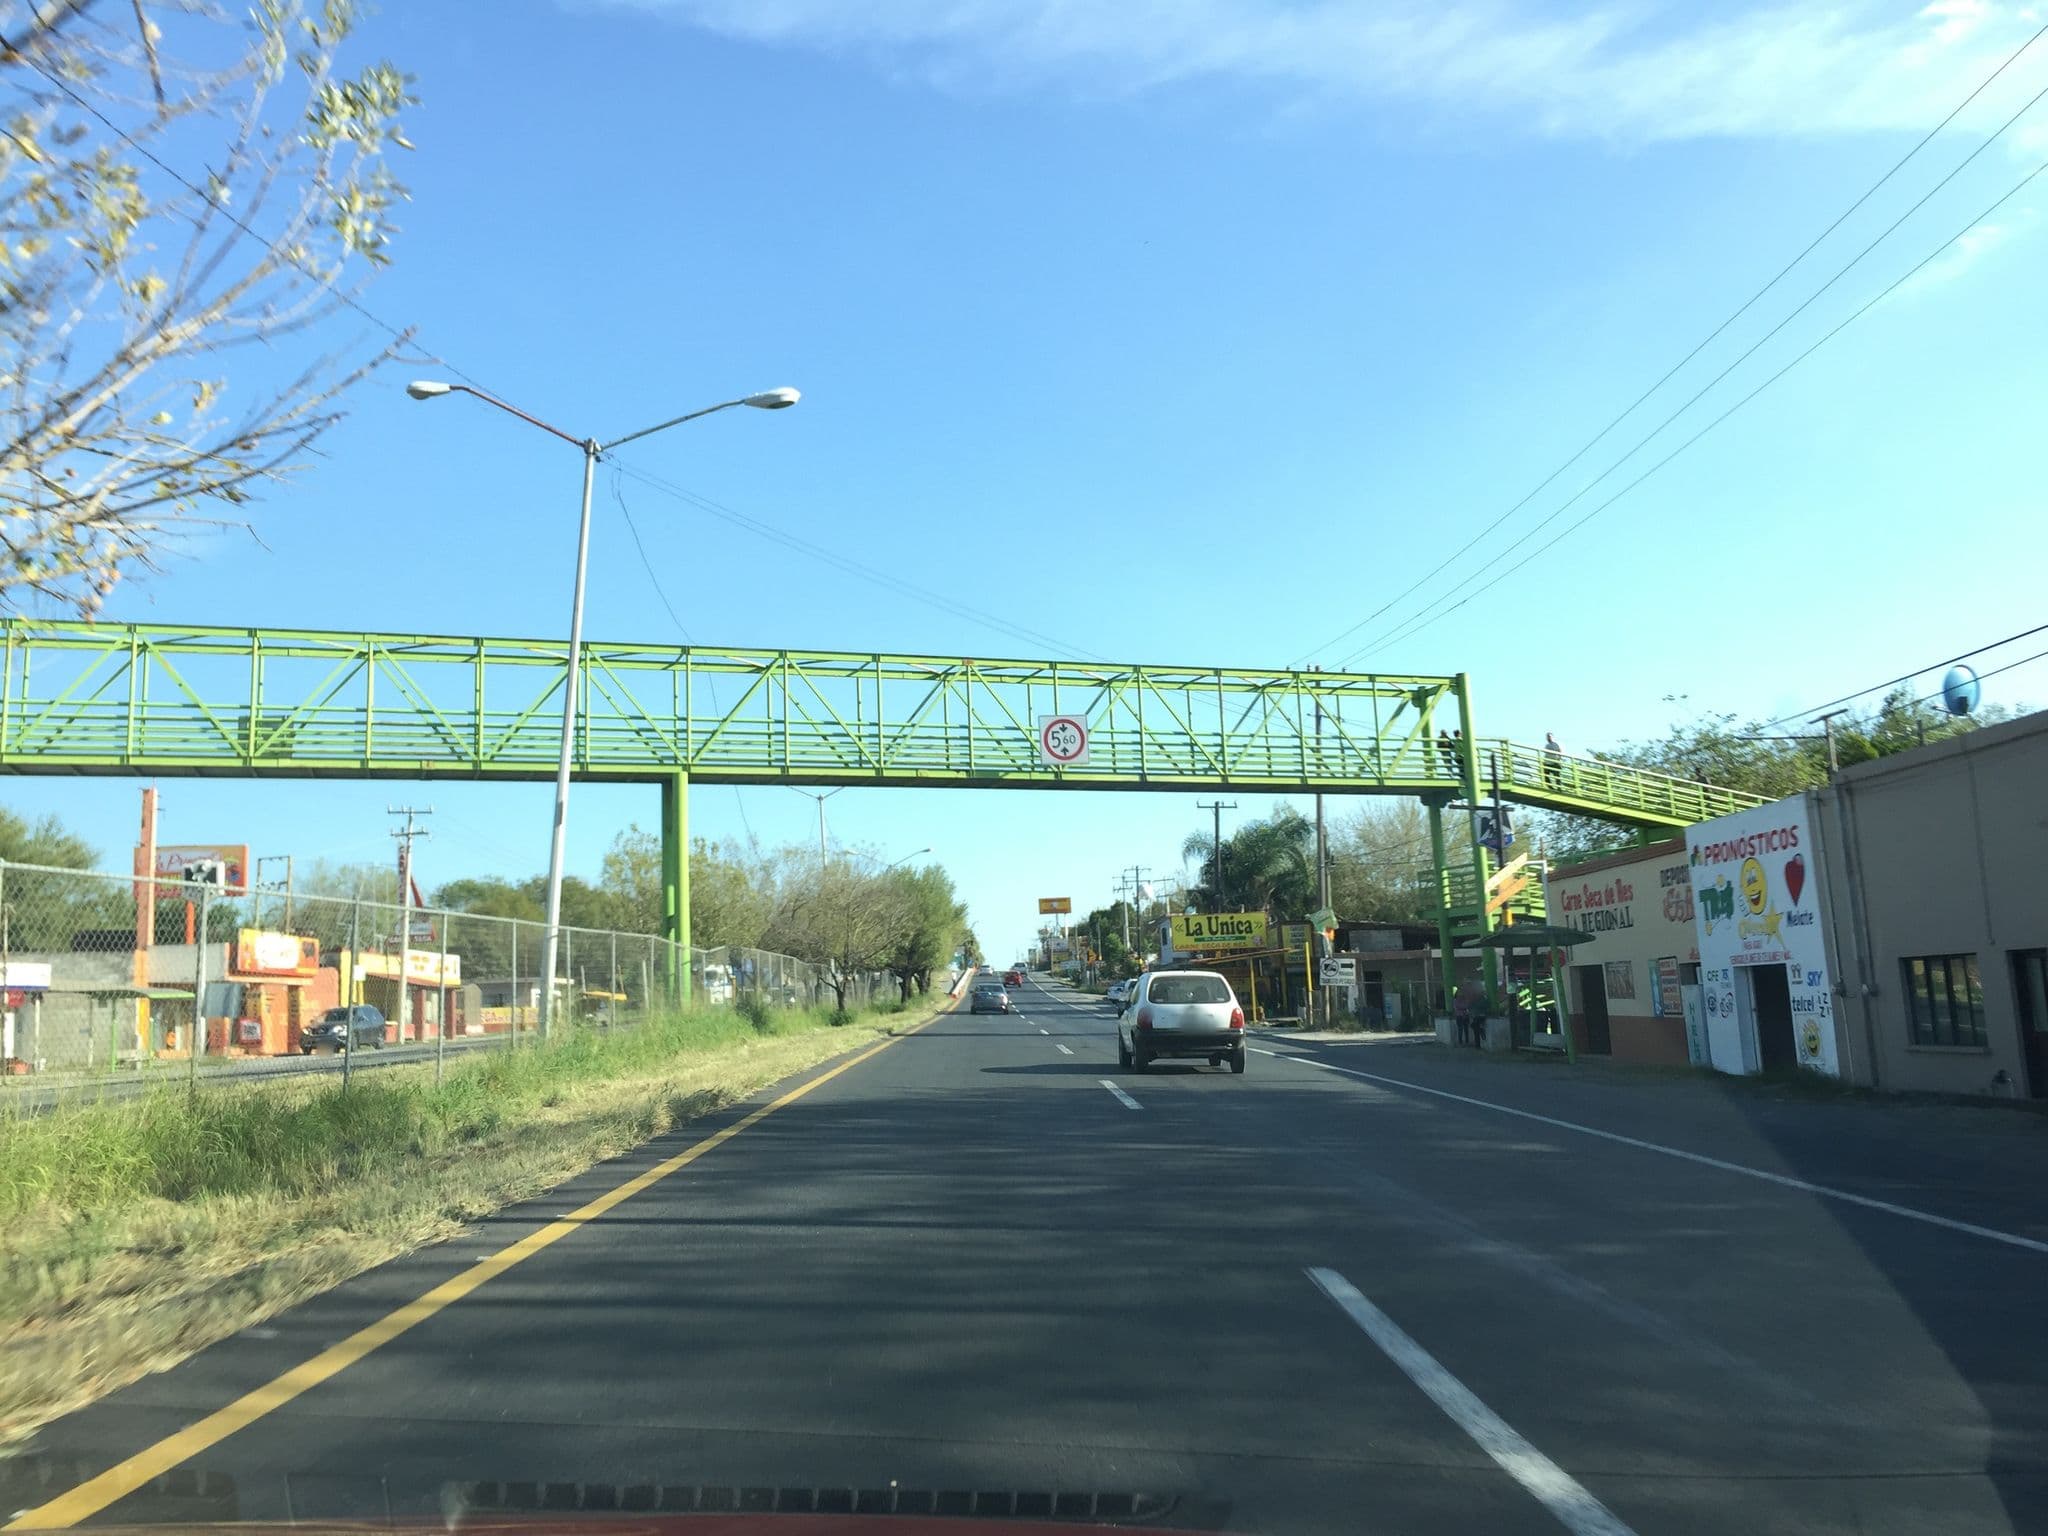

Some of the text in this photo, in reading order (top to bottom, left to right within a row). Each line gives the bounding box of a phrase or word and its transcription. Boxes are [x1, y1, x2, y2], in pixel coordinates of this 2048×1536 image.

[1561, 878, 1633, 911] Carne Seca de Res
[1184, 915, 1253, 936] La Unica
[1581, 906, 1634, 933] REGIONAL
[1787, 910, 1813, 927] Melate
[1706, 970, 1719, 981] CFE
[1807, 971, 1823, 986] SKY
[1792, 994, 1815, 1012] telcel
